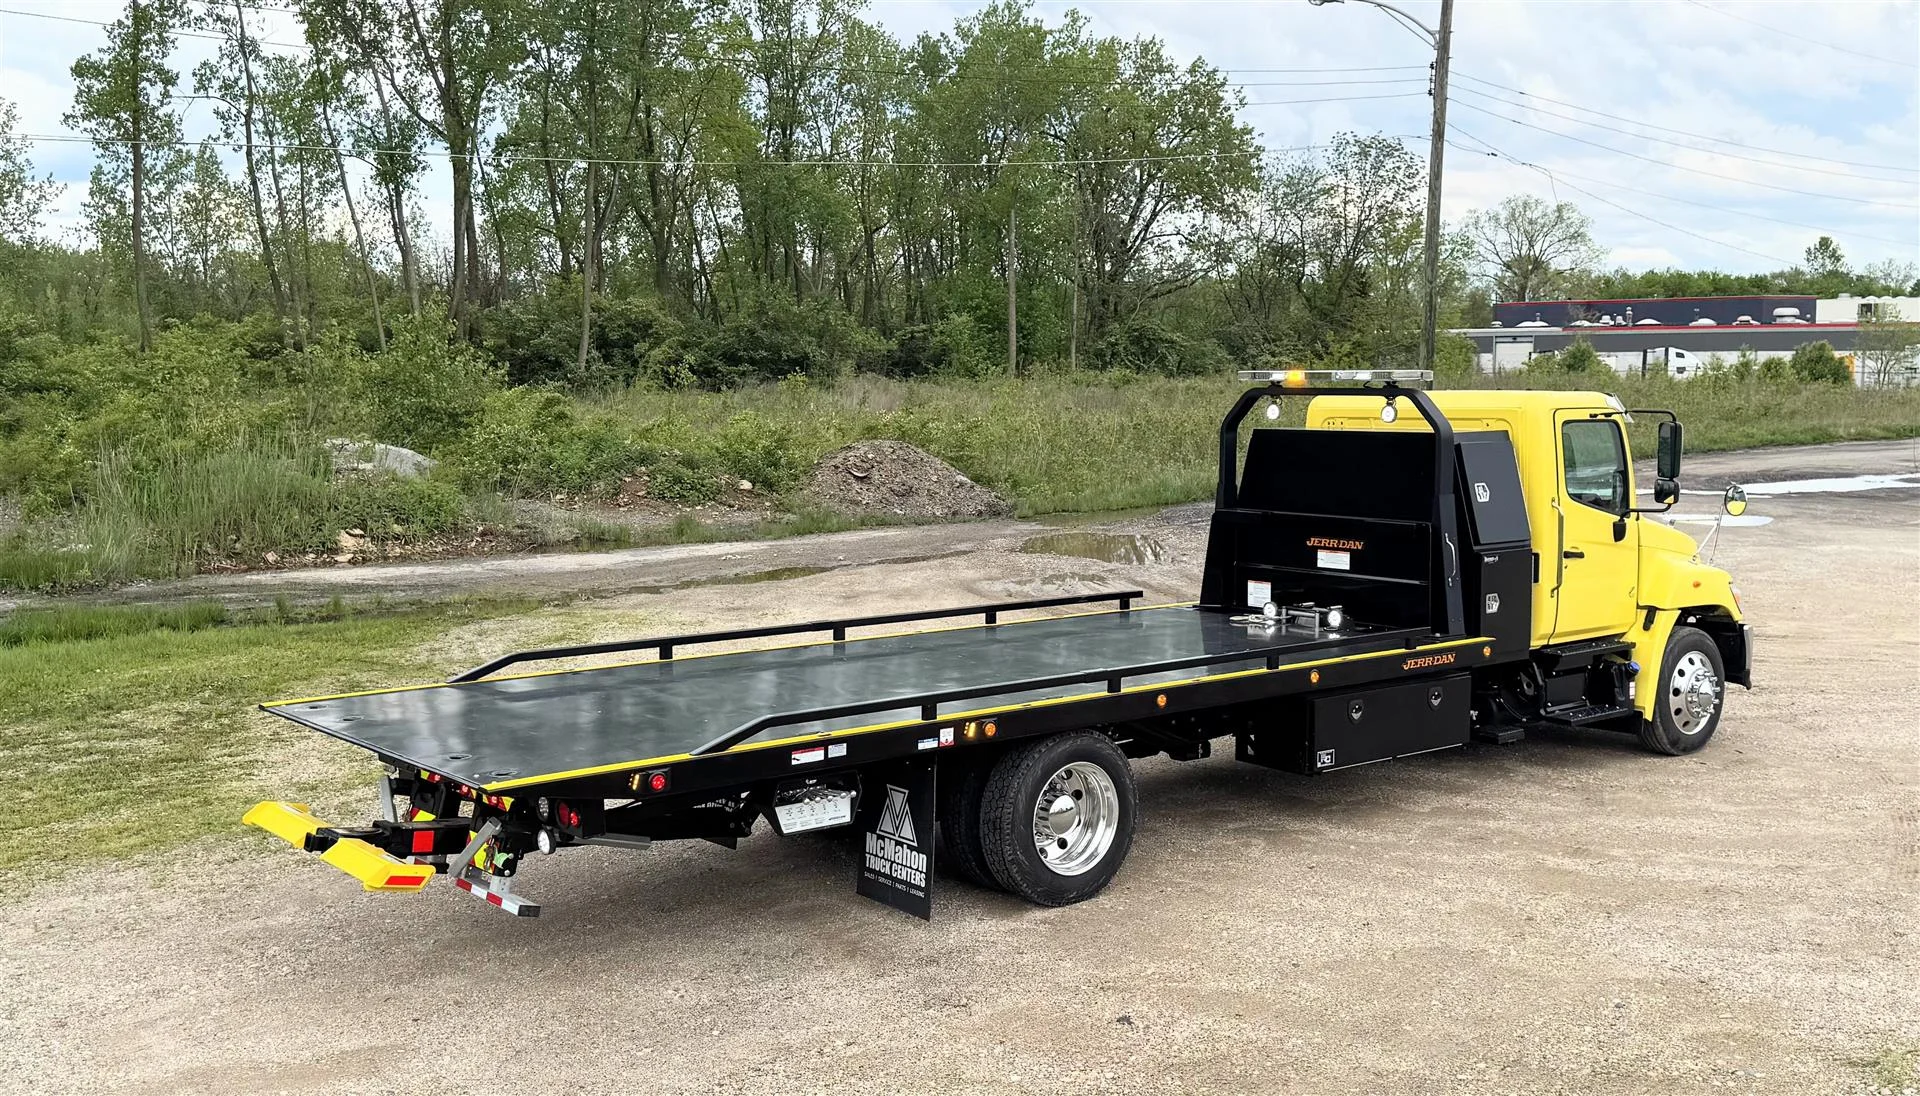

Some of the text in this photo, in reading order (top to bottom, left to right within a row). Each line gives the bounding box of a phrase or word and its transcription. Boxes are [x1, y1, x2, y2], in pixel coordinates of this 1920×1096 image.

[865, 832, 927, 873] McMahon
[865, 853, 926, 888] TRUCK CENTERS
